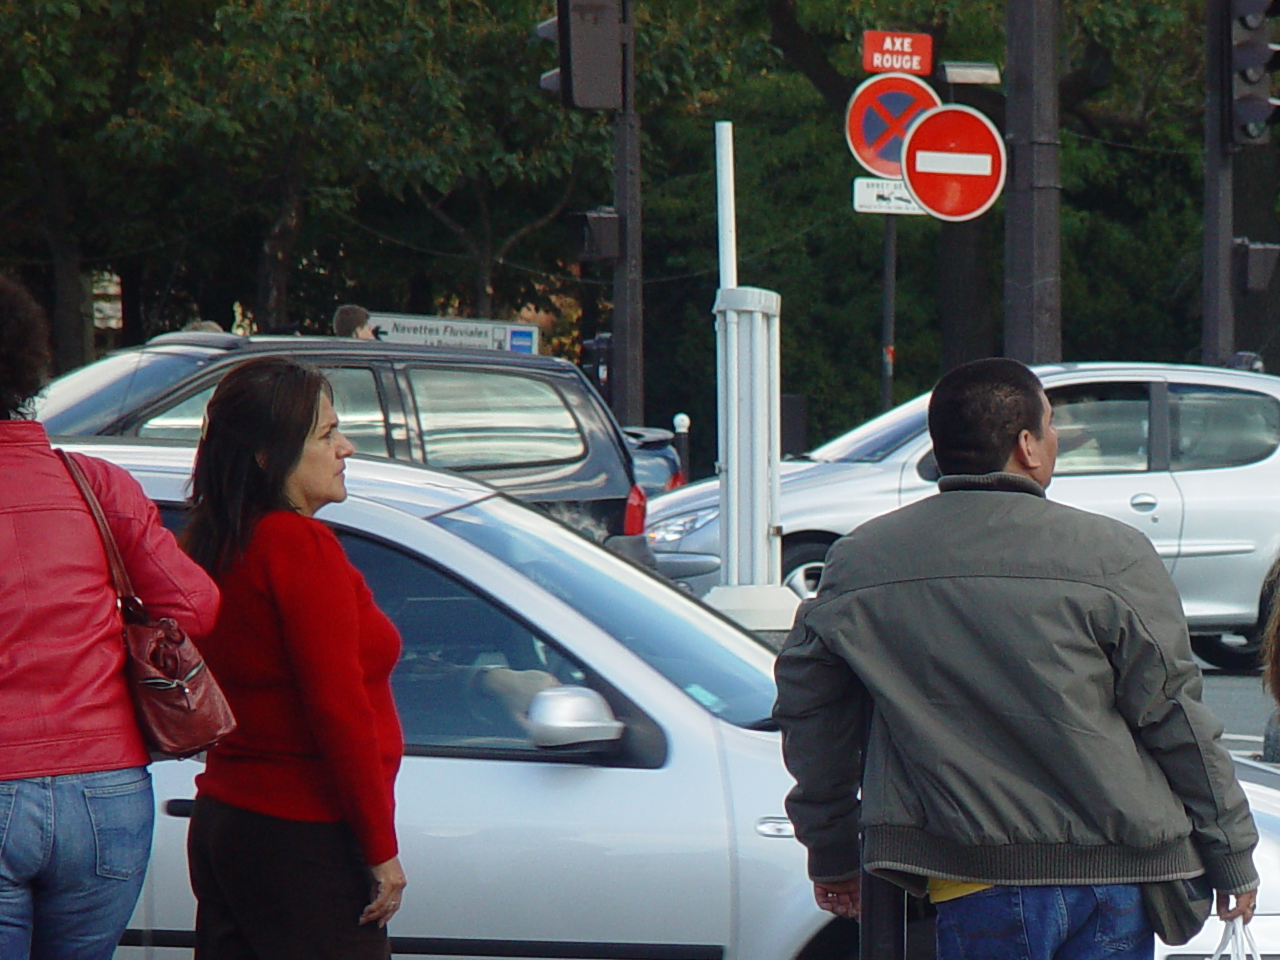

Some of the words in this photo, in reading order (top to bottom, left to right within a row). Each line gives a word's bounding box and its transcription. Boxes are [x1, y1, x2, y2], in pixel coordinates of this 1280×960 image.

[882, 36, 913, 53] AXE
[872, 52, 922, 71] ROUGE
[391, 321, 440, 337] Navettes
[443, 325, 489, 339] Fluviales
